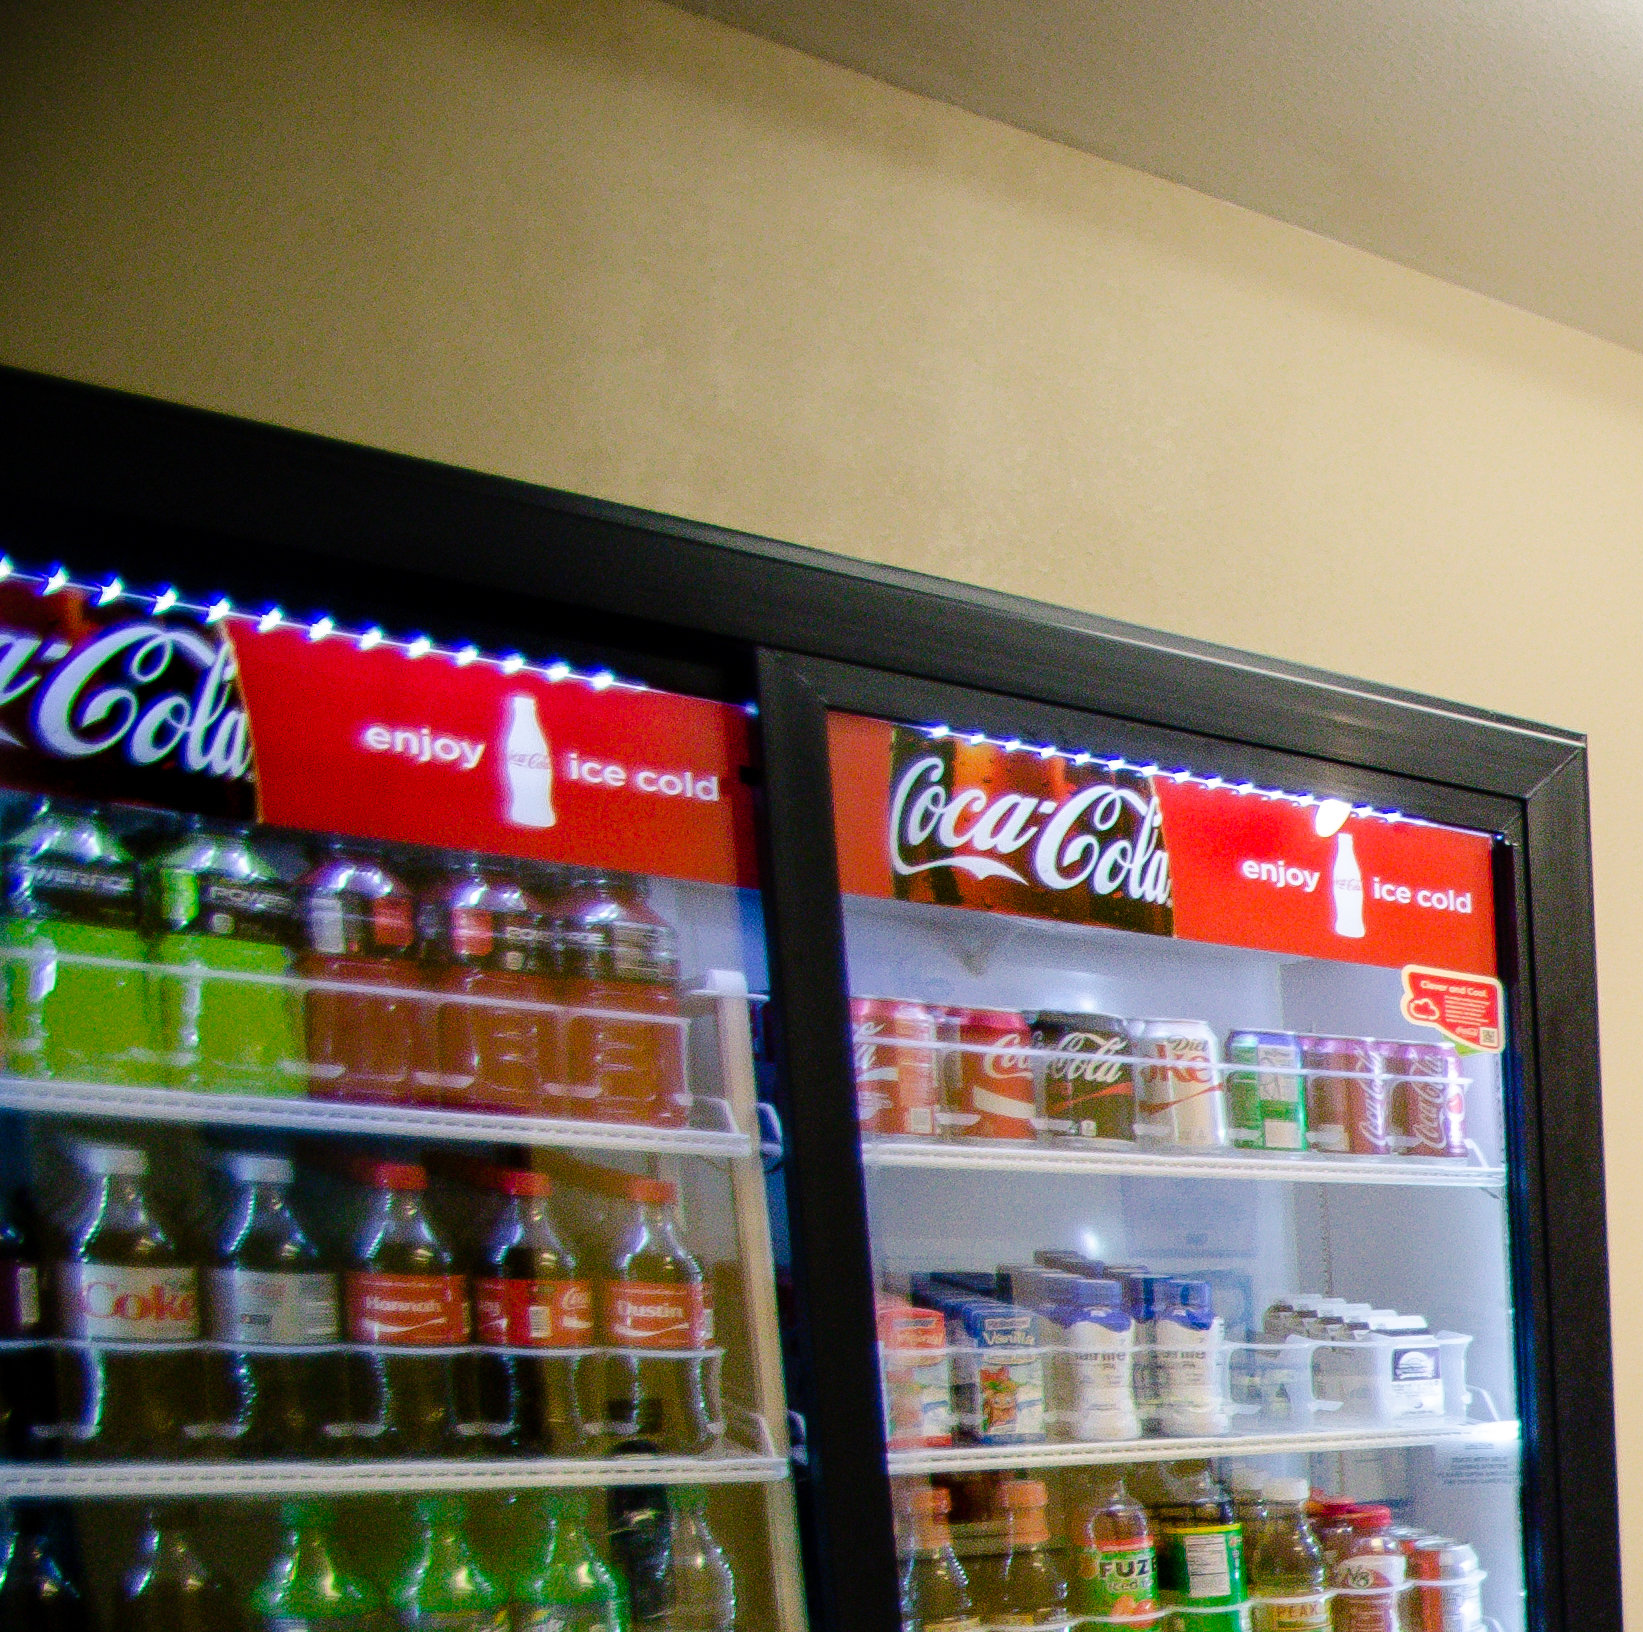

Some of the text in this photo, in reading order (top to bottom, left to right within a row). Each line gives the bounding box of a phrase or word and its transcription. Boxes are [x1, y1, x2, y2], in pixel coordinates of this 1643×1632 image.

[0, 624, 252, 780] a-Cola
[362, 722, 486, 770] enjoy
[566, 752, 721, 802] ice cold
[889, 756, 1172, 906] Coca-Cola
[1243, 857, 1320, 894] enjoy
[1373, 876, 1411, 904] ice
[1417, 882, 1472, 914] cold
